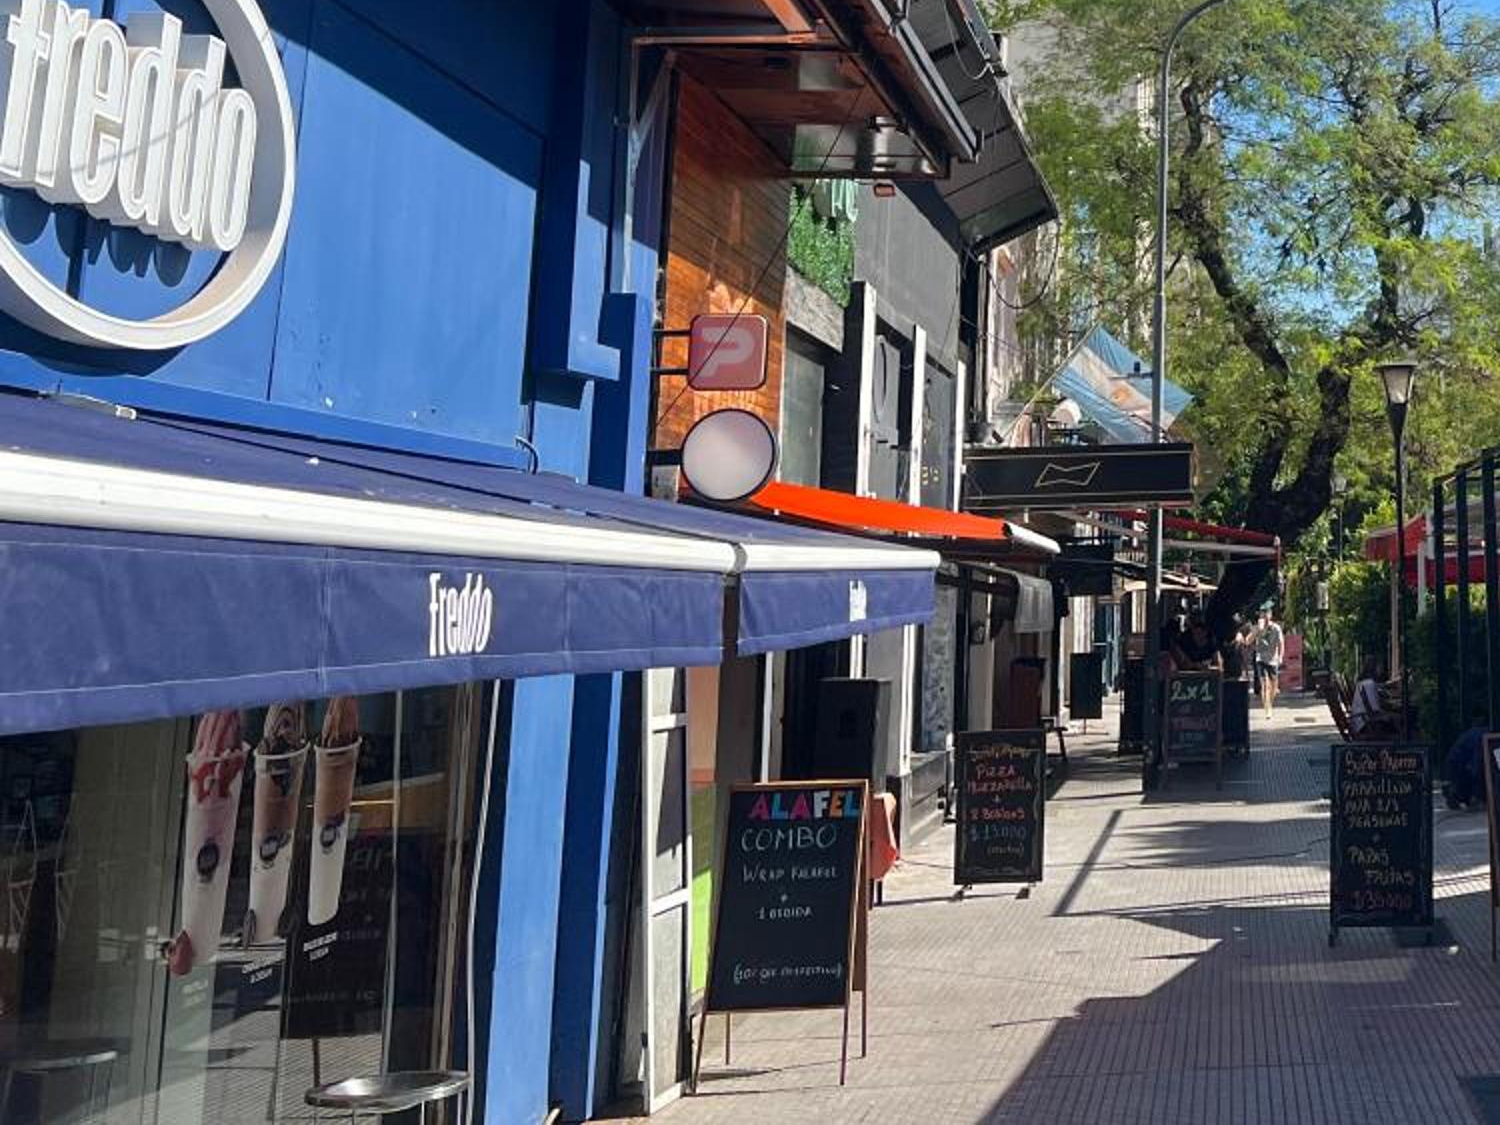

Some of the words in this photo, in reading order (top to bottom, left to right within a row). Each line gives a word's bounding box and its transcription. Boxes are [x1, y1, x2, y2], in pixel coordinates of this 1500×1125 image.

[430, 573, 492, 657] freddo
[749, 789, 861, 820] ALAFEL
[741, 825, 837, 851] COMBO
